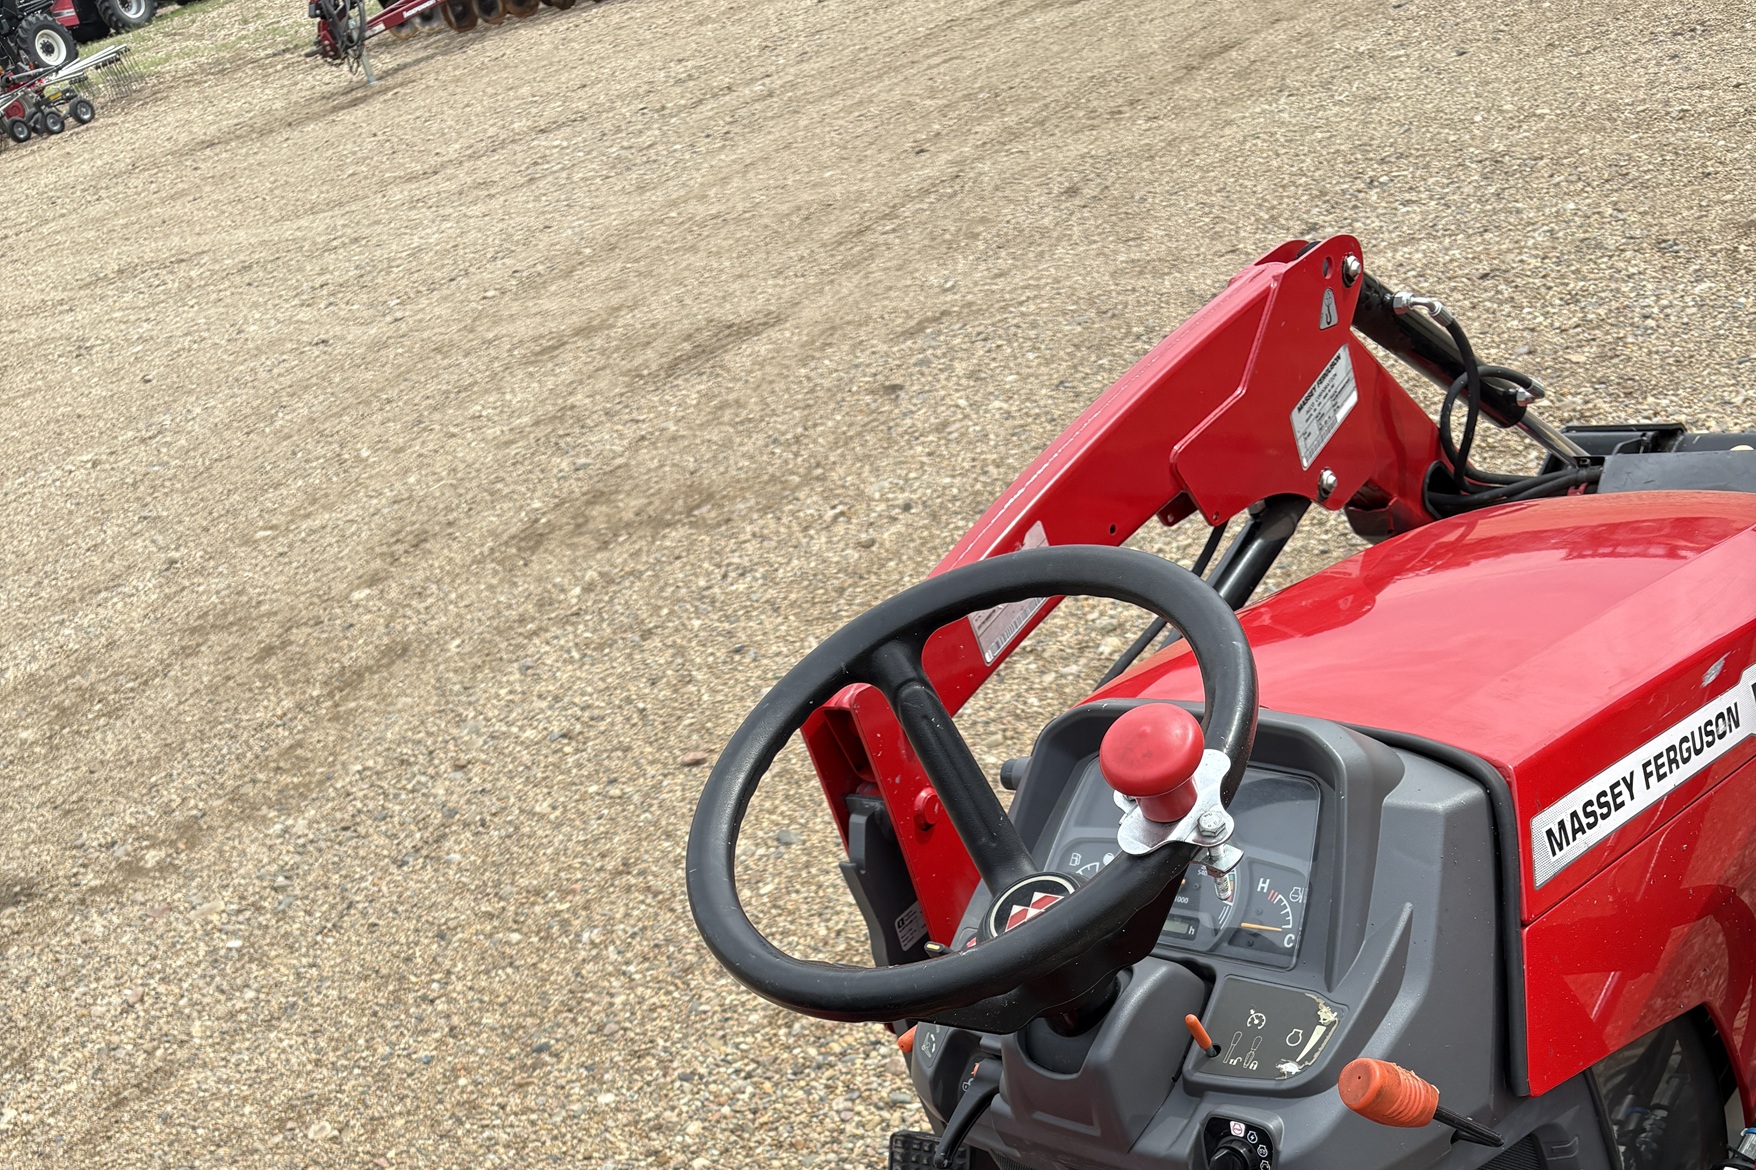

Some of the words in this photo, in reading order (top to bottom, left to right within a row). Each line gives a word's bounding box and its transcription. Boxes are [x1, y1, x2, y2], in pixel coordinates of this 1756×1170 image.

[1297, 383, 1317, 414] MASSEY
[1545, 770, 1635, 857] MASSEY
[1641, 702, 1741, 790] FERGUSON
[1256, 877, 1271, 893] H
[1283, 933, 1296, 948] C
